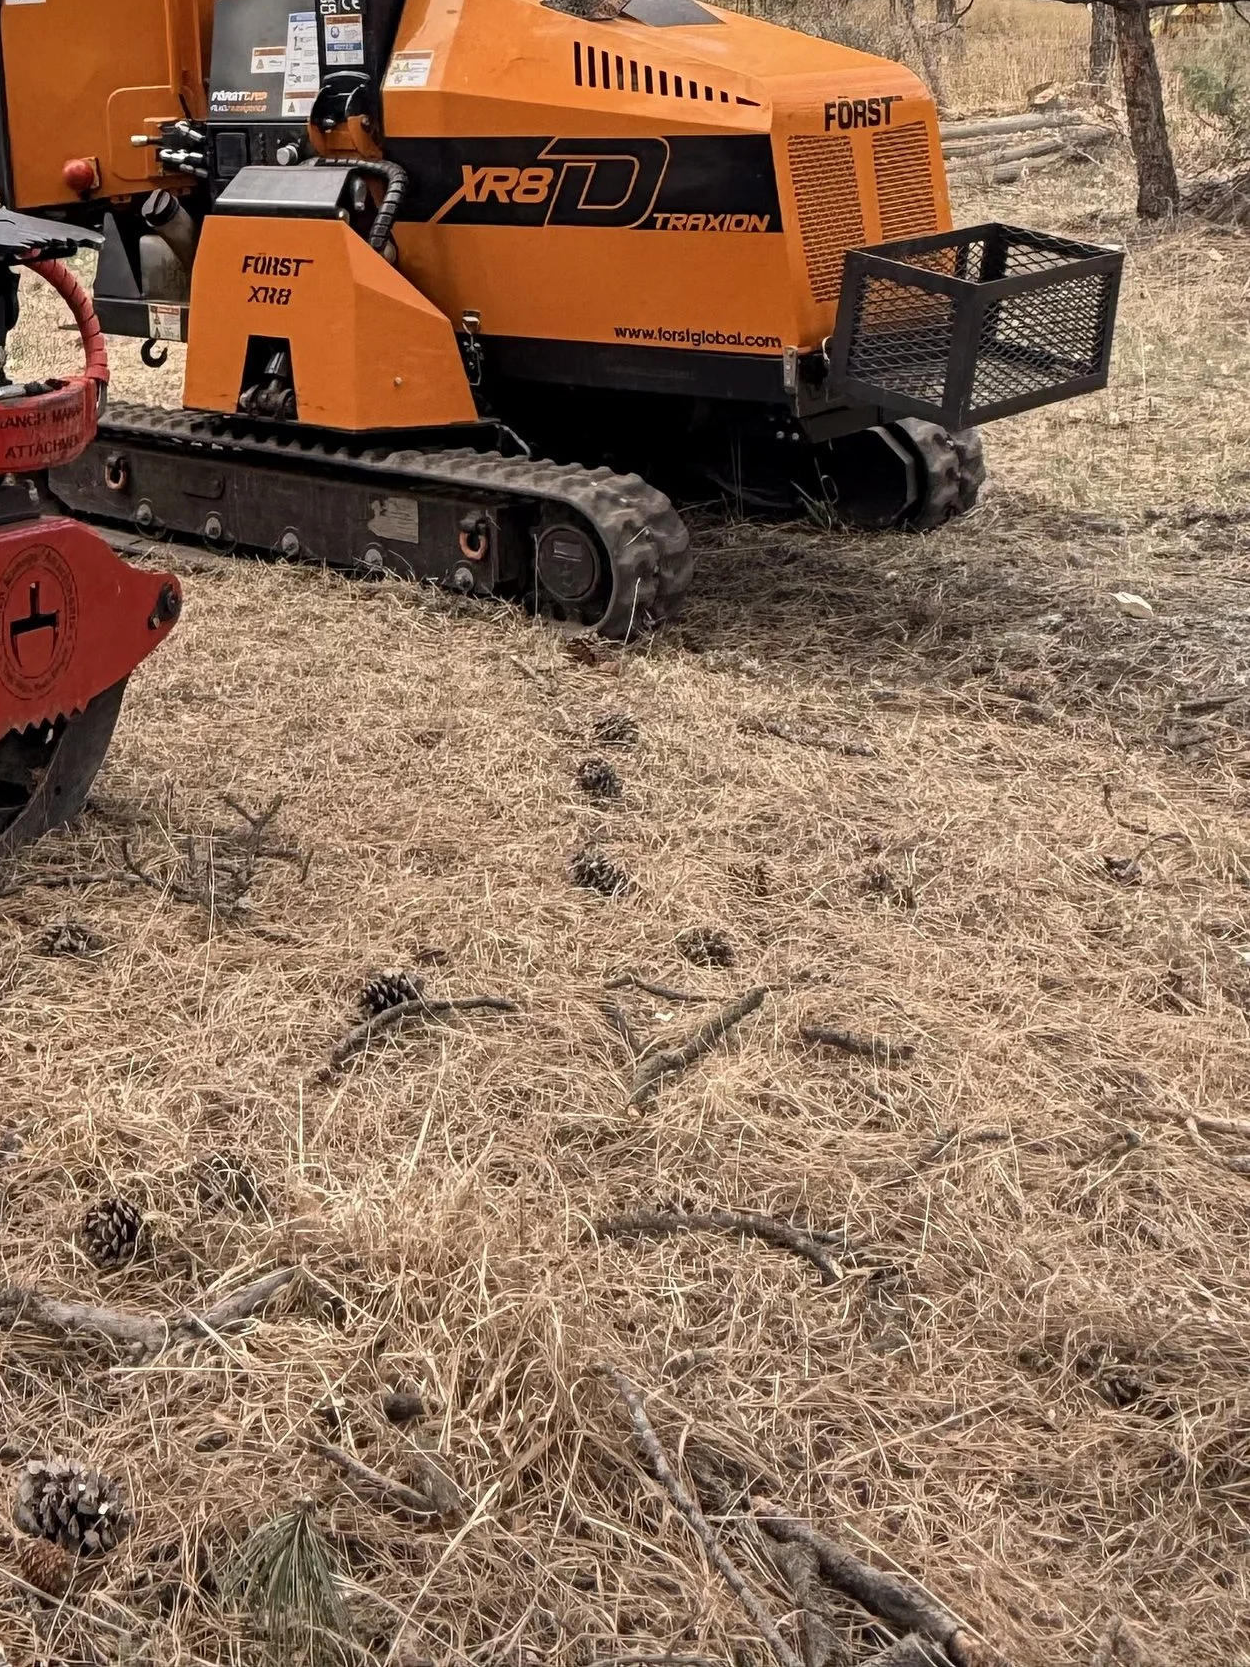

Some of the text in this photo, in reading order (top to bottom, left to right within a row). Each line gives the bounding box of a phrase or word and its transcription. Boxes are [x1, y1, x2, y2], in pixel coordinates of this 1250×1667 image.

[448, 164, 555, 208] XR8
[653, 213, 770, 233] TRAXION
[247, 285, 292, 306] XR8
[614, 327, 782, 348] www.forstglobal.com
